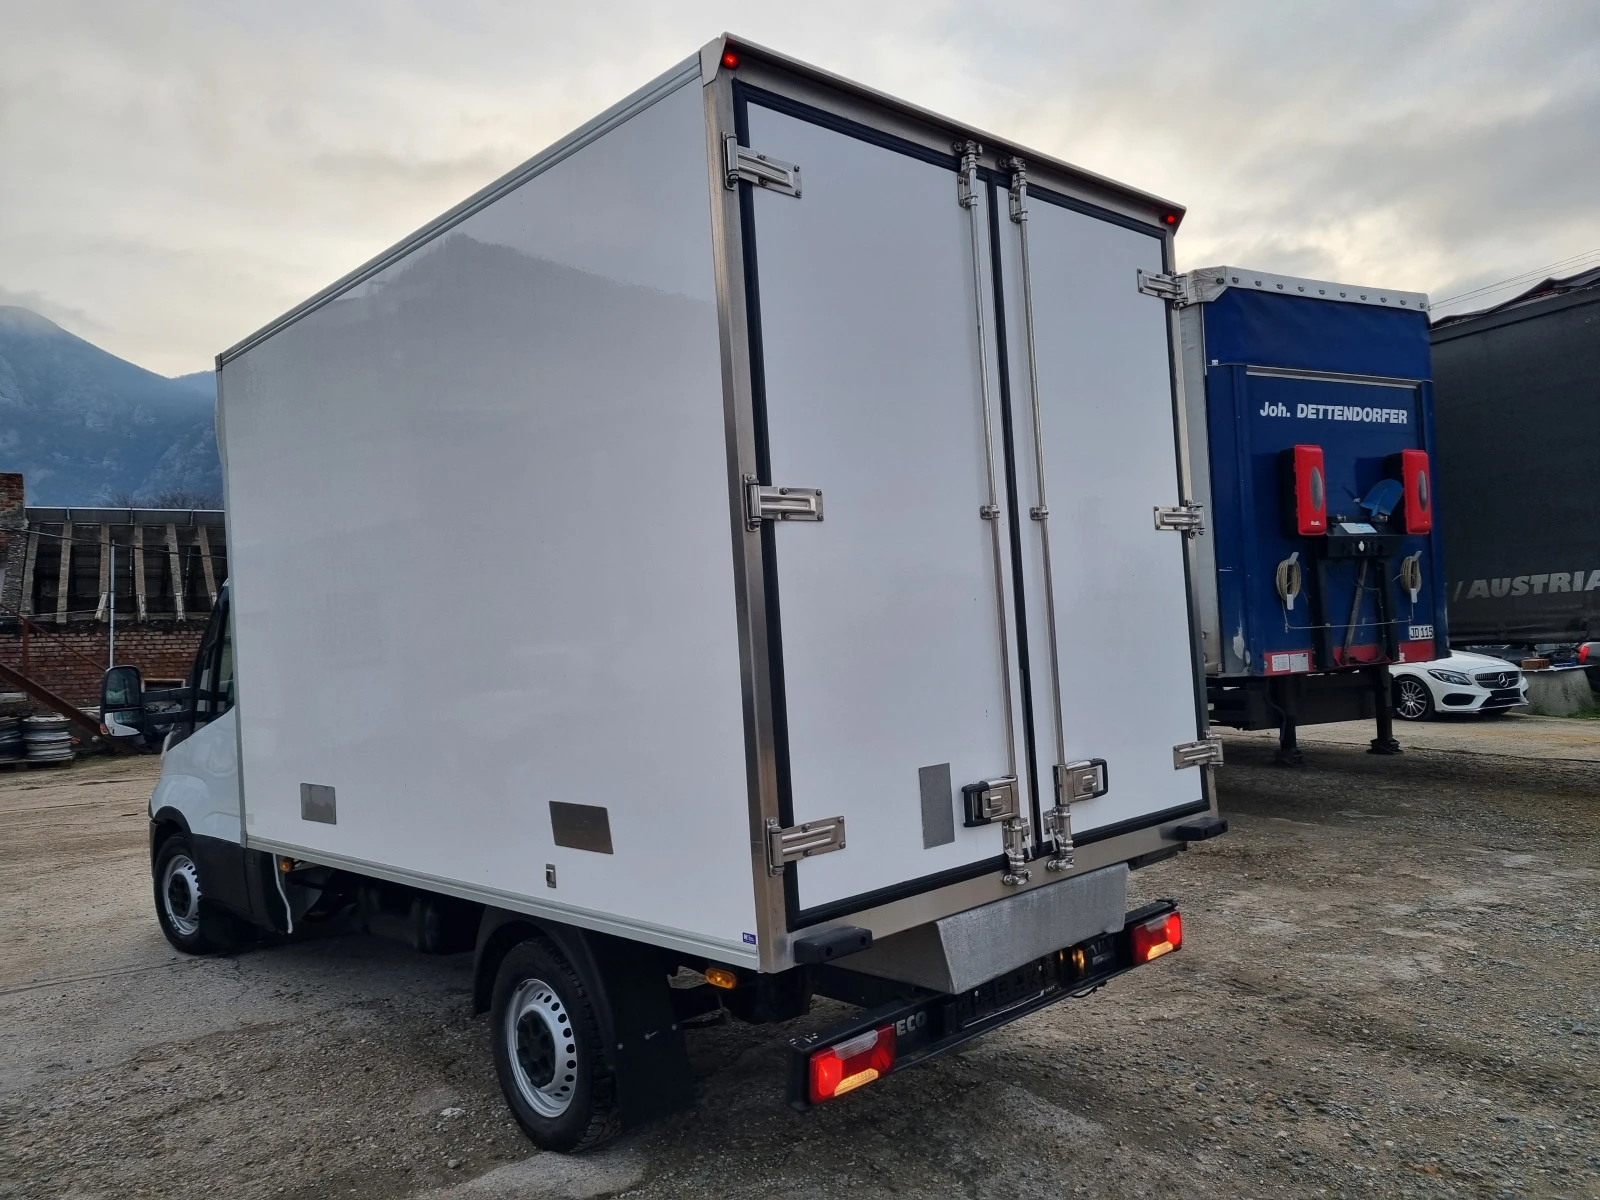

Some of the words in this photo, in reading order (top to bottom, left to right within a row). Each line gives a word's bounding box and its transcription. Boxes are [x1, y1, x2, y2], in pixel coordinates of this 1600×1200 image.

[1260, 401, 1290, 417] Joh.
[1297, 403, 1408, 424] DETTENDORFER
[1420, 626, 1433, 638] 115
[891, 1010, 927, 1037] ECO
